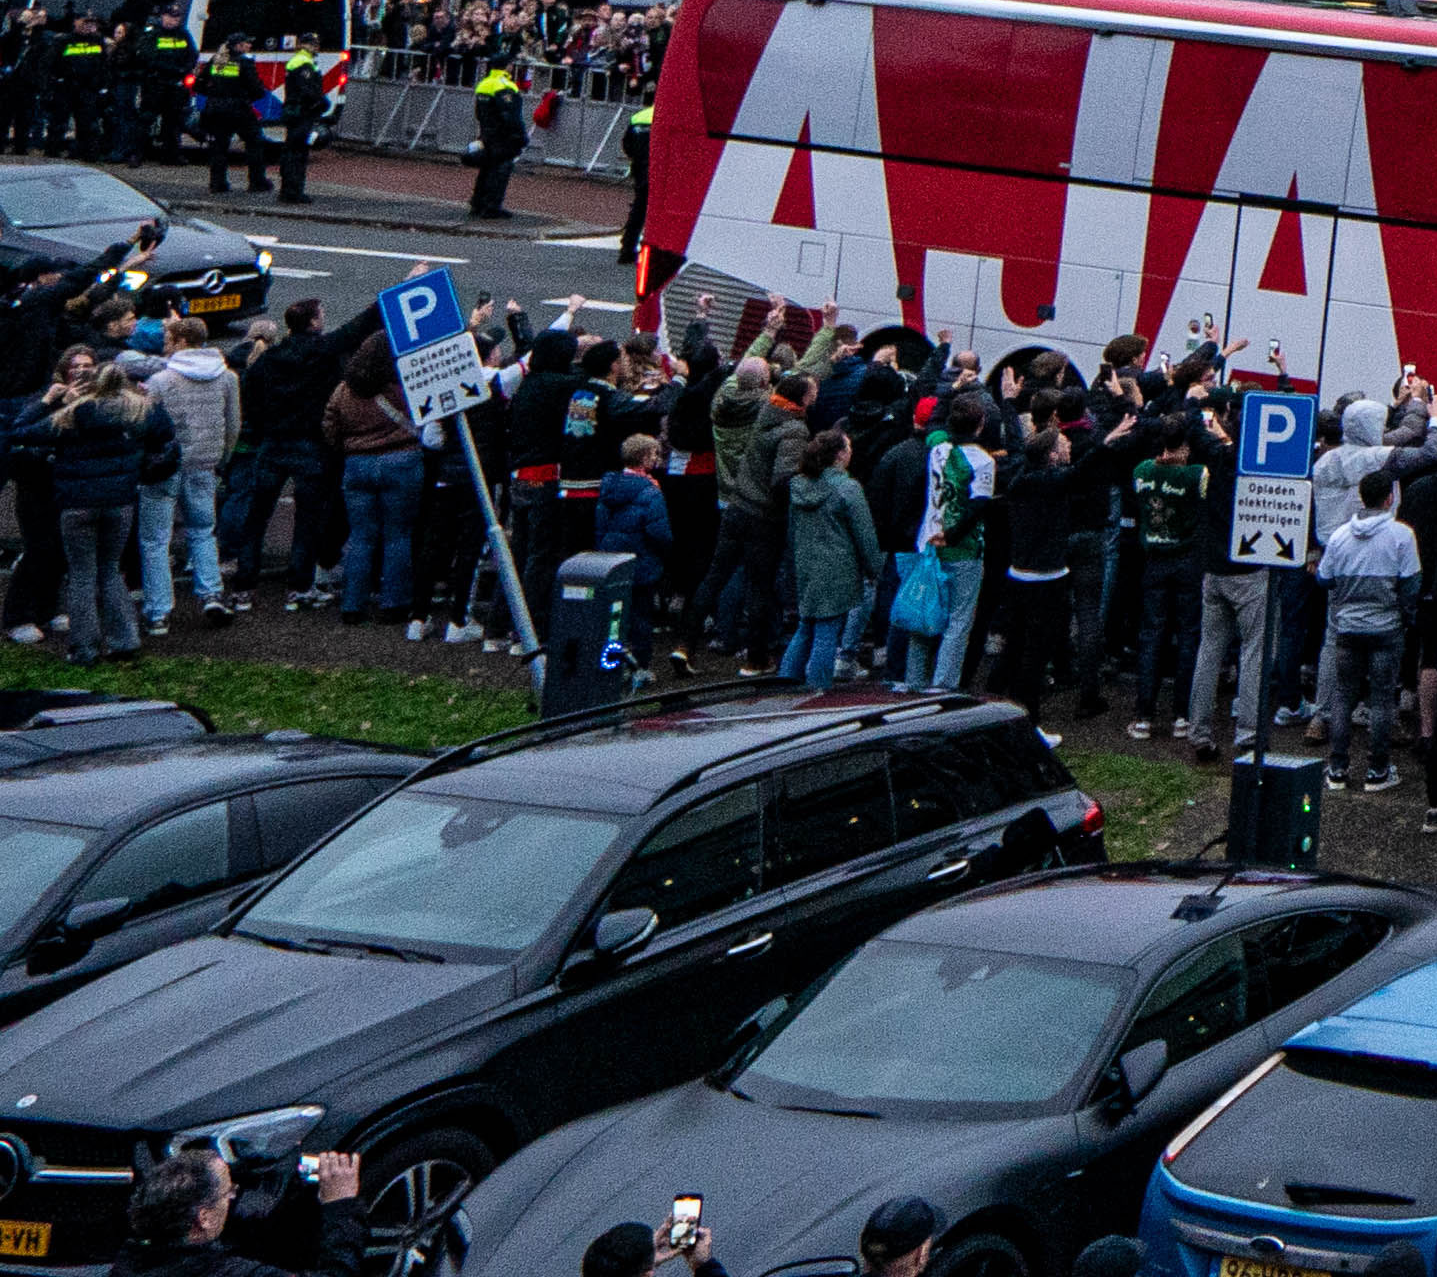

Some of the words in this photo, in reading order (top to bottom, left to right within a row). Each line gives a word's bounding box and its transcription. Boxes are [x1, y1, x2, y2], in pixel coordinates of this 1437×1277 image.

[398, 286, 437, 342] P
[410, 343, 460, 367] Opladen
[1256, 403, 1297, 465] P
[1248, 482, 1296, 496] Opladen
[1238, 498, 1304, 512] elektrische
[1238, 511, 1301, 528] voertuigen
